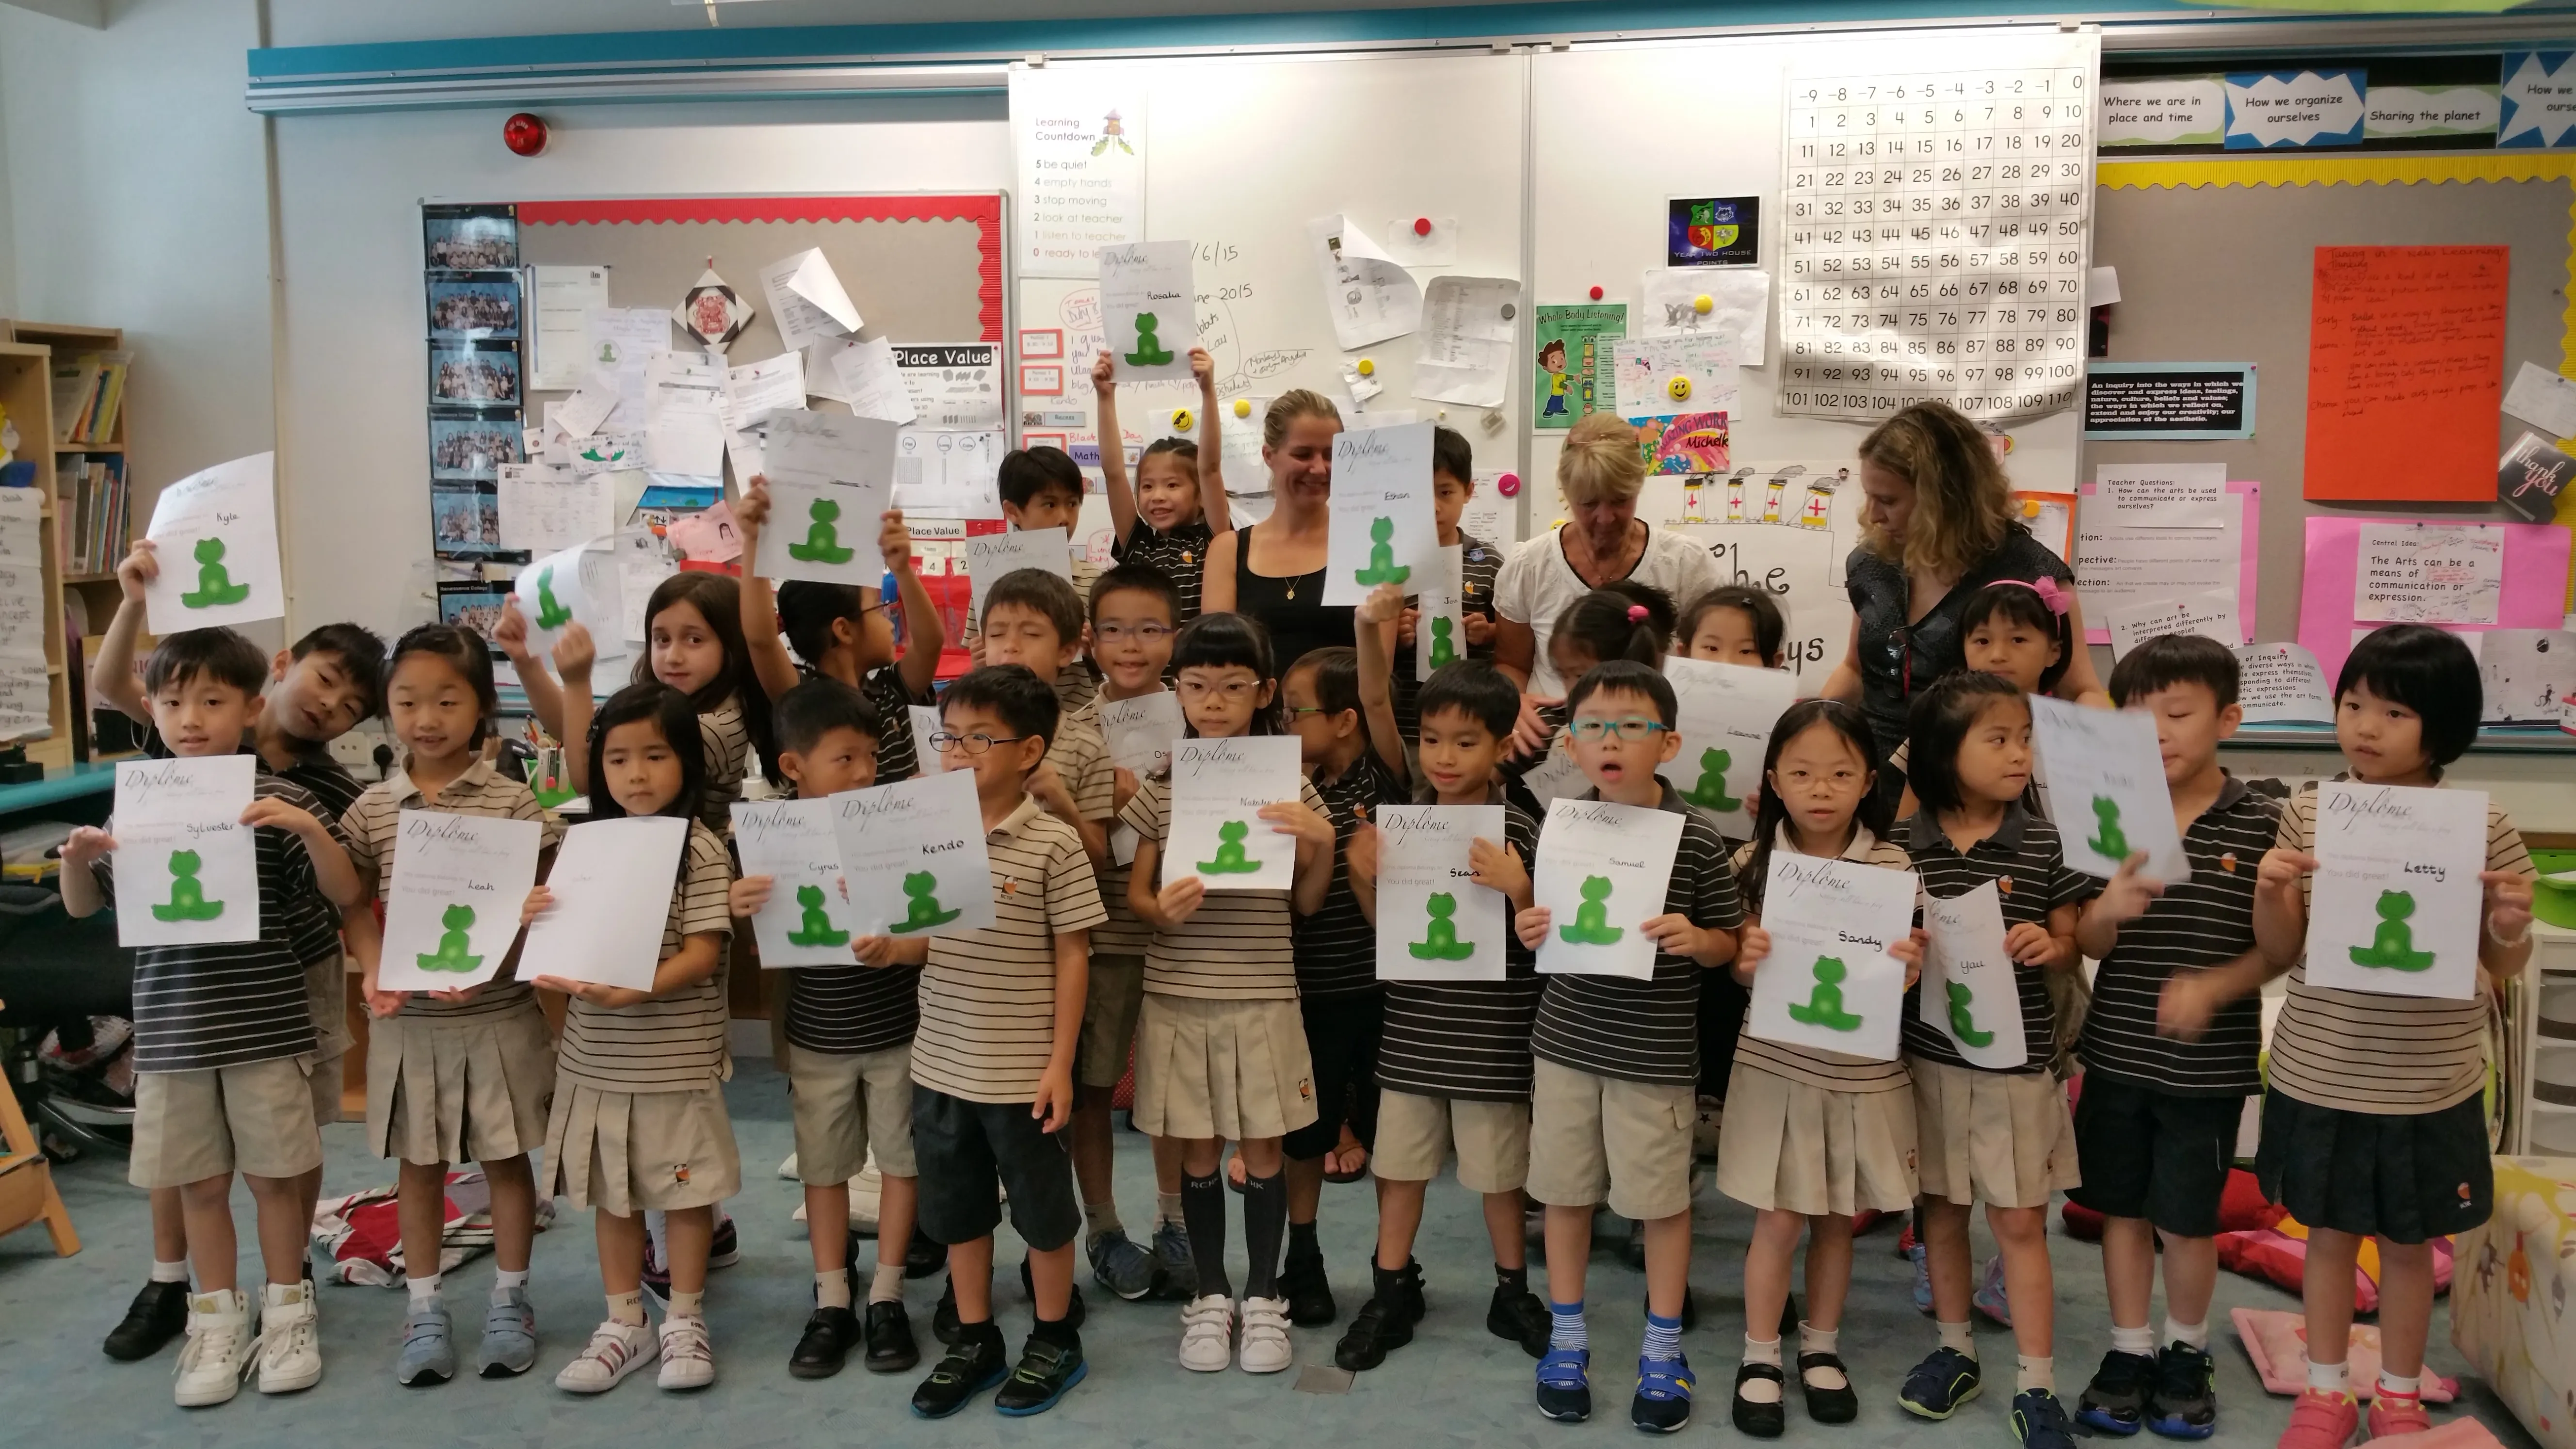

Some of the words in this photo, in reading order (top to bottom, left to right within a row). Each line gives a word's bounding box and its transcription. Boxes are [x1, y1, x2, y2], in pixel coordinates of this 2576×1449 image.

[2528, 84, 2552, 94] How
[2104, 97, 2141, 106] Where
[2192, 96, 2201, 105] in
[2246, 98, 2269, 107] How
[2295, 96, 2343, 107] organize
[2109, 112, 2137, 124] place
[2143, 113, 2162, 122] and
[2169, 113, 2192, 122] time
[2268, 112, 2319, 123] ourselves
[2370, 111, 2414, 123] Sharing
[2420, 111, 2438, 120] the
[2445, 111, 2480, 122] planet
[1036, 118, 1079, 129] Learning
[1036, 132, 1095, 141] Countdown
[1044, 160, 1057, 169] be
[1061, 161, 1086, 171] quiet
[1796, 175, 1812, 187] 21
[1826, 173, 1844, 186] 22
[1854, 172, 1873, 184] 23
[1884, 170, 1902, 183] 24
[1913, 169, 1931, 182] 25
[1943, 168, 1961, 181] 26
[1972, 166, 1991, 179] 27
[2002, 165, 2020, 178] 28
[2031, 164, 2049, 177] 29
[2061, 163, 2080, 176] 30
[1044, 178, 1077, 188] empty
[1081, 178, 1111, 187] hands
[1034, 195, 1040, 204] 3
[1043, 196, 1065, 206] stop
[1069, 196, 1107, 207] moving
[1043, 213, 1064, 222] look
[1068, 214, 1078, 223] at
[1082, 214, 1123, 223] teacher
[1043, 231, 1068, 240] listen
[1072, 232, 1081, 240] to
[1085, 232, 1126, 241] teacher
[1033, 248, 1039, 257] 0
[1045, 250, 1076, 259] ready
[1079, 250, 1089, 258] to
[1220, 283, 1252, 300] 2015
[1794, 289, 1809, 301] 61
[1823, 288, 1840, 300] 62
[1852, 286, 1870, 299] 63
[1881, 286, 1899, 298] 64
[1910, 285, 1928, 297] 65
[1940, 284, 1958, 296] 66
[1969, 282, 1988, 295] 67
[1999, 281, 2017, 294] 68
[2029, 280, 2047, 293] 69
[2059, 280, 2077, 292] 70
[1539, 311, 1563, 324] Whole
[1565, 309, 1584, 321] Body
[1587, 309, 1624, 323] Listening!
[894, 350, 938, 365] Place
[945, 350, 990, 364] Value
[1075, 452, 1099, 460] Math
[2516, 446, 2565, 482] thank
[2512, 470, 2558, 497] you
[217, 513, 240, 525] Kyle
[907, 527, 932, 535] Place
[934, 527, 960, 535] Value
[930, 563, 935, 571] 4
[961, 561, 967, 570] 2
[2371, 556, 2389, 565] The
[2396, 557, 2417, 565] Arts
[2449, 559, 2462, 567] be
[2408, 569, 2419, 578] of
[2369, 581, 2446, 590] communication
[2368, 593, 2426, 602] expression.
[2132, 622, 2146, 630] Why
[2133, 624, 2172, 635] interpreted
[2176, 616, 2212, 628] differently
[2218, 613, 2225, 623] by
[1180, 739, 1245, 776] Diplôme
[2328, 788, 2413, 830] Diplôme
[187, 822, 235, 839] Sylvester
[1385, 807, 1449, 845] Diplôme
[407, 816, 478, 853] Diplôme
[922, 839, 965, 855] Kendo
[1609, 857, 1645, 868] Samuel
[809, 862, 838, 875] Cyrus
[1450, 868, 1481, 877] Sean
[2404, 861, 2446, 882] Letty
[1778, 861, 1850, 897] Diplôme
[468, 880, 495, 890] Leah
[1838, 931, 1883, 952] Sandy
